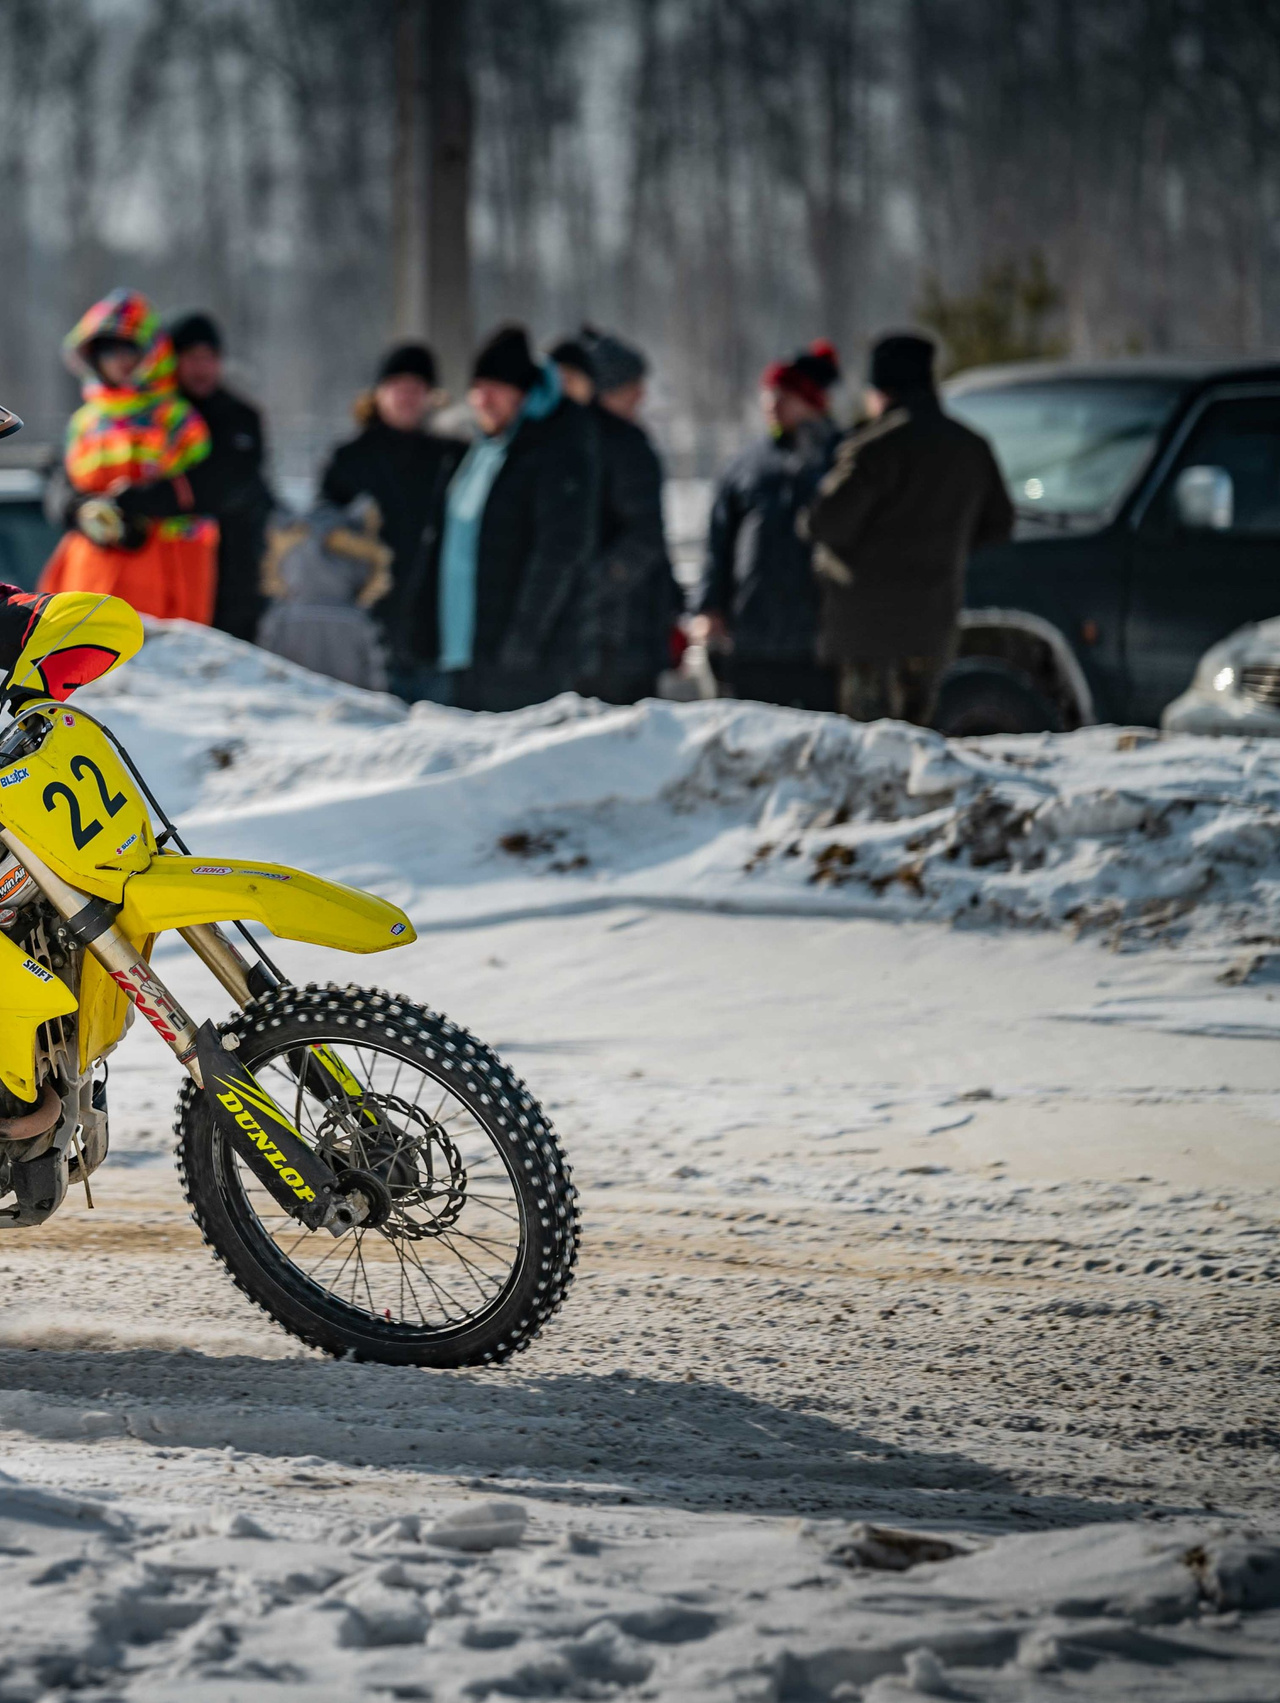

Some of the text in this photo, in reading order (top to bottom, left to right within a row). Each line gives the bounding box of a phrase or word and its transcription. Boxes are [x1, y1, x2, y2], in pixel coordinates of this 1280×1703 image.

[42, 755, 128, 851] 22
[23, 959, 54, 982] SHIFT
[216, 1091, 317, 1203] DUNLOP
